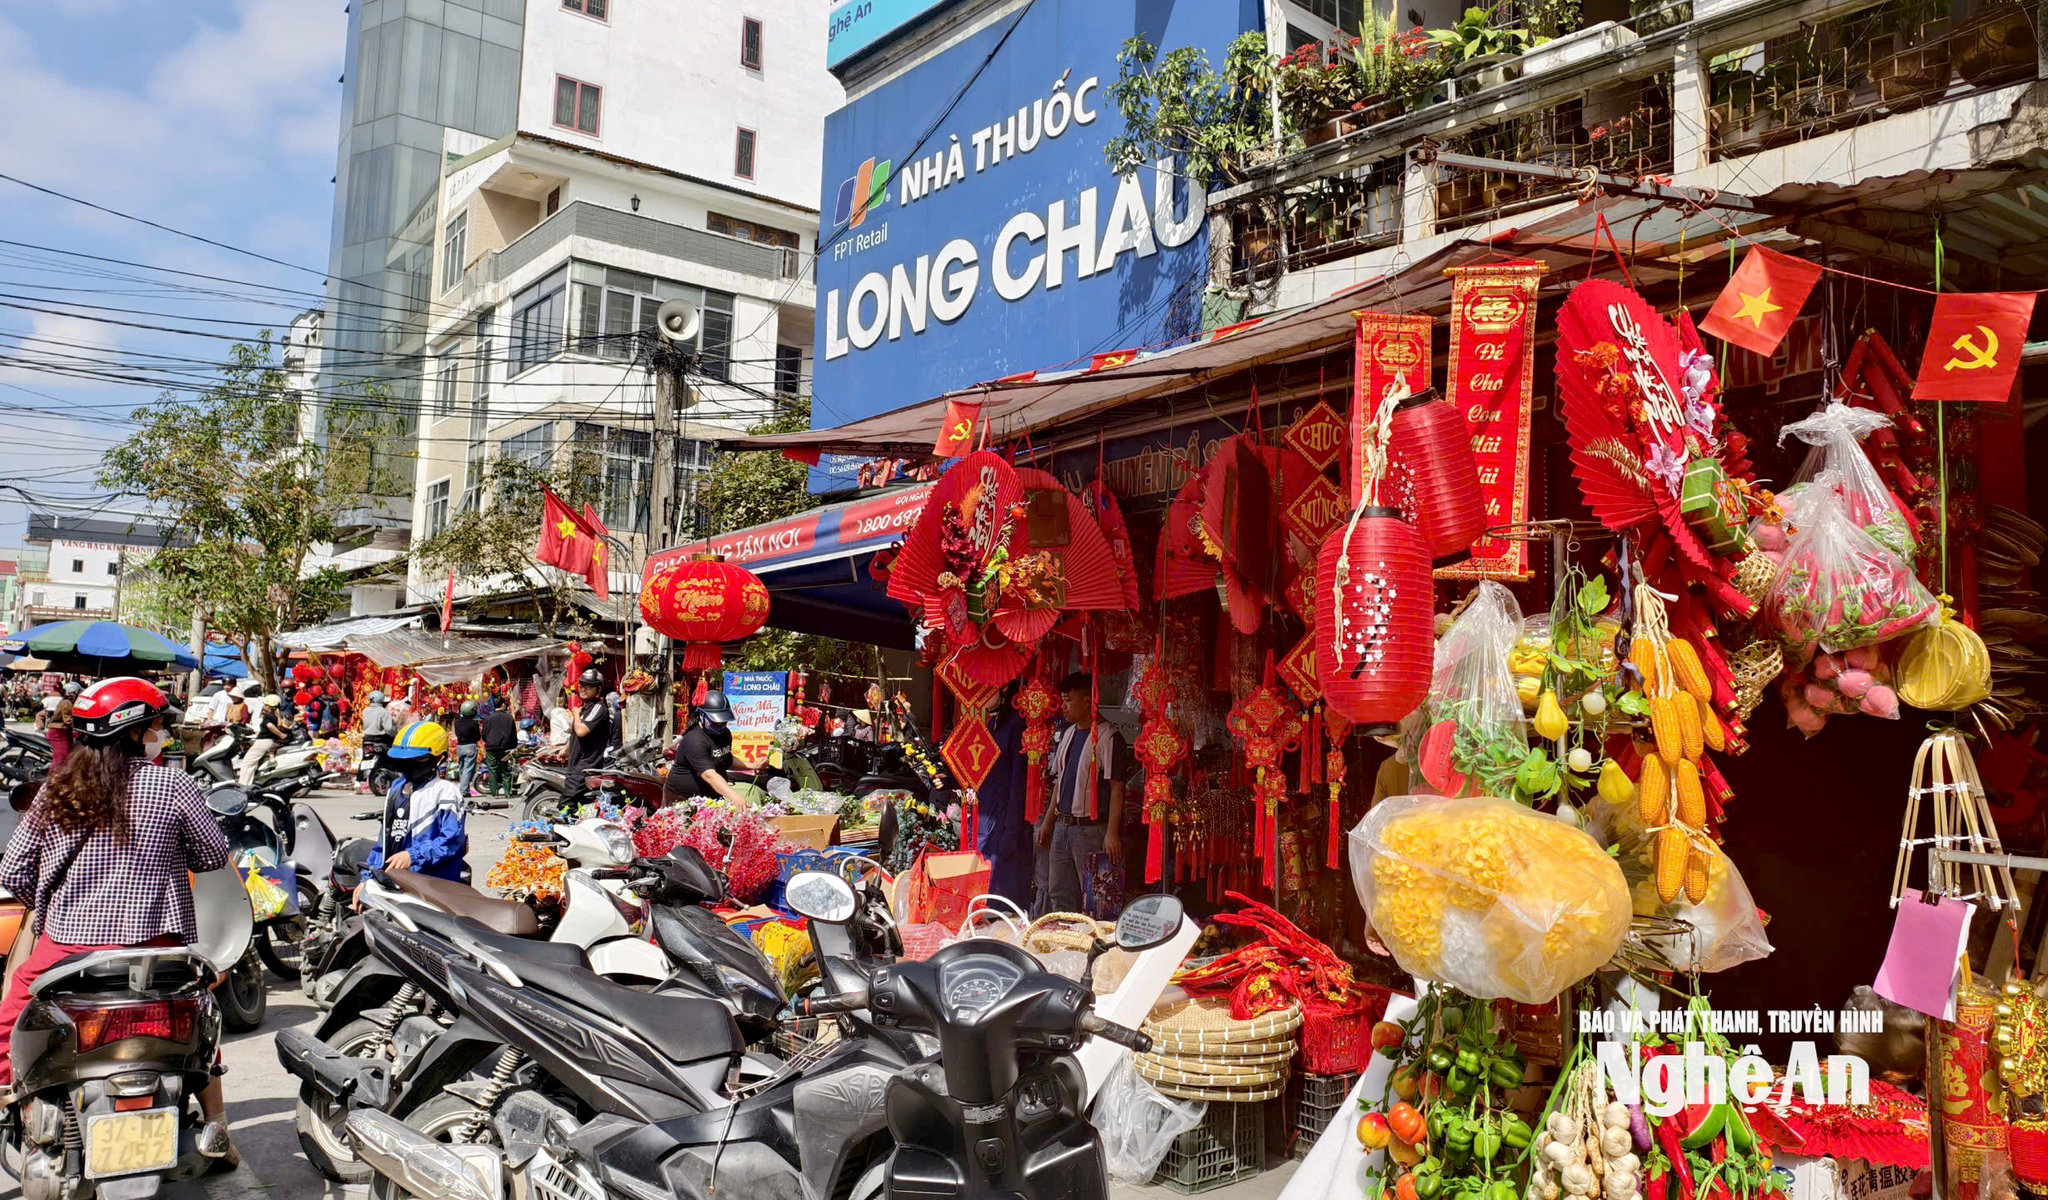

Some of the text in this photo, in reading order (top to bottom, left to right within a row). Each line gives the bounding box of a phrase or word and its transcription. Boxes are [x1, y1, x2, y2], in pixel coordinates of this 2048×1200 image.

[854, 2, 872, 23] An
[901, 67, 1099, 206] NHÀ THUỐC
[834, 222, 888, 262] FPT Retail
[825, 153, 1206, 361] LONG CHÂU
[1470, 373, 1503, 392] Cho
[1468, 404, 1502, 423] Con
[1300, 415, 1343, 452] CHÚC
[1477, 466, 1500, 484] ãi
[896, 495, 909, 505] GỌI
[857, 514, 891, 535] 1800
[736, 535, 766, 560] TẬN
[768, 527, 800, 550] NƠI
[744, 683, 761, 691] LONG
[762, 681, 780, 691] CHÂU
[756, 674, 773, 682] THUỐC
[755, 711, 775, 727] phá
